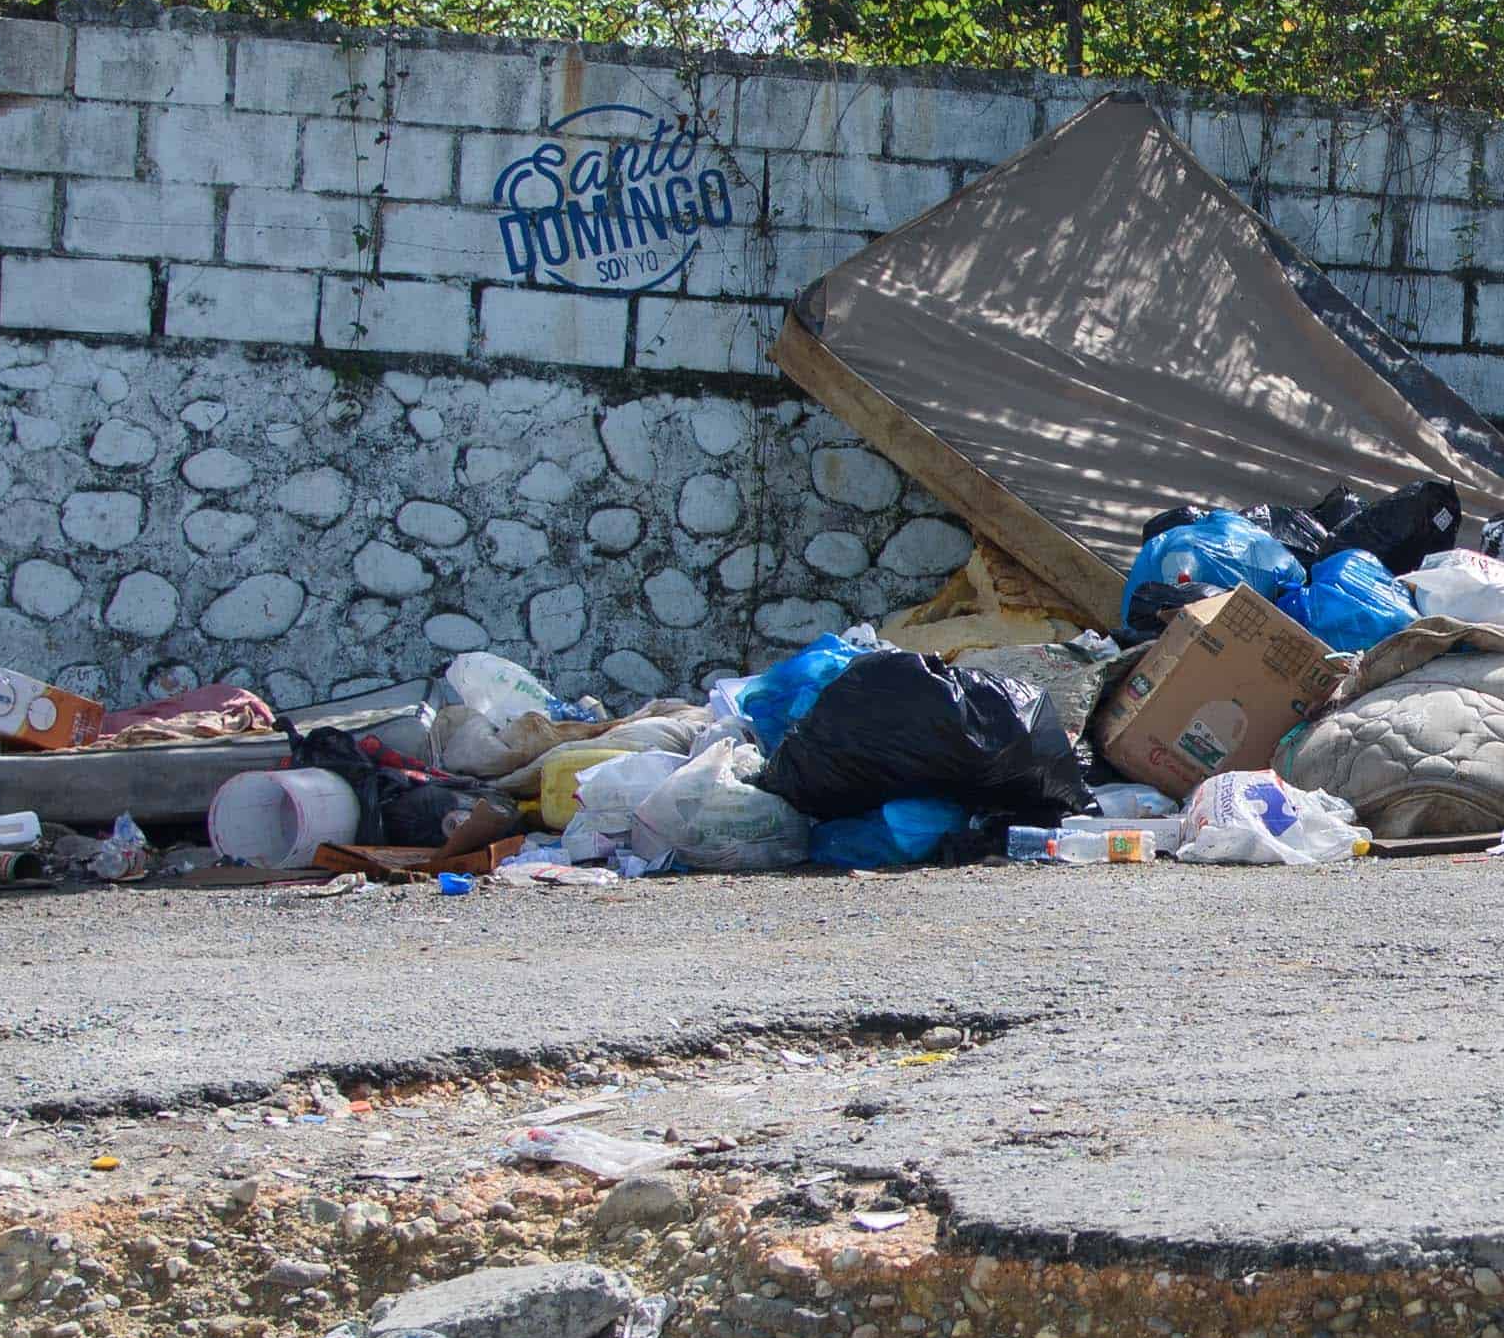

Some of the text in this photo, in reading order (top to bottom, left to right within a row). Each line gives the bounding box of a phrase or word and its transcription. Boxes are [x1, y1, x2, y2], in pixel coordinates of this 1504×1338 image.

[499, 117, 699, 214] Santo
[498, 169, 733, 275] DOMINGO
[596, 249, 658, 282] SOY YO
